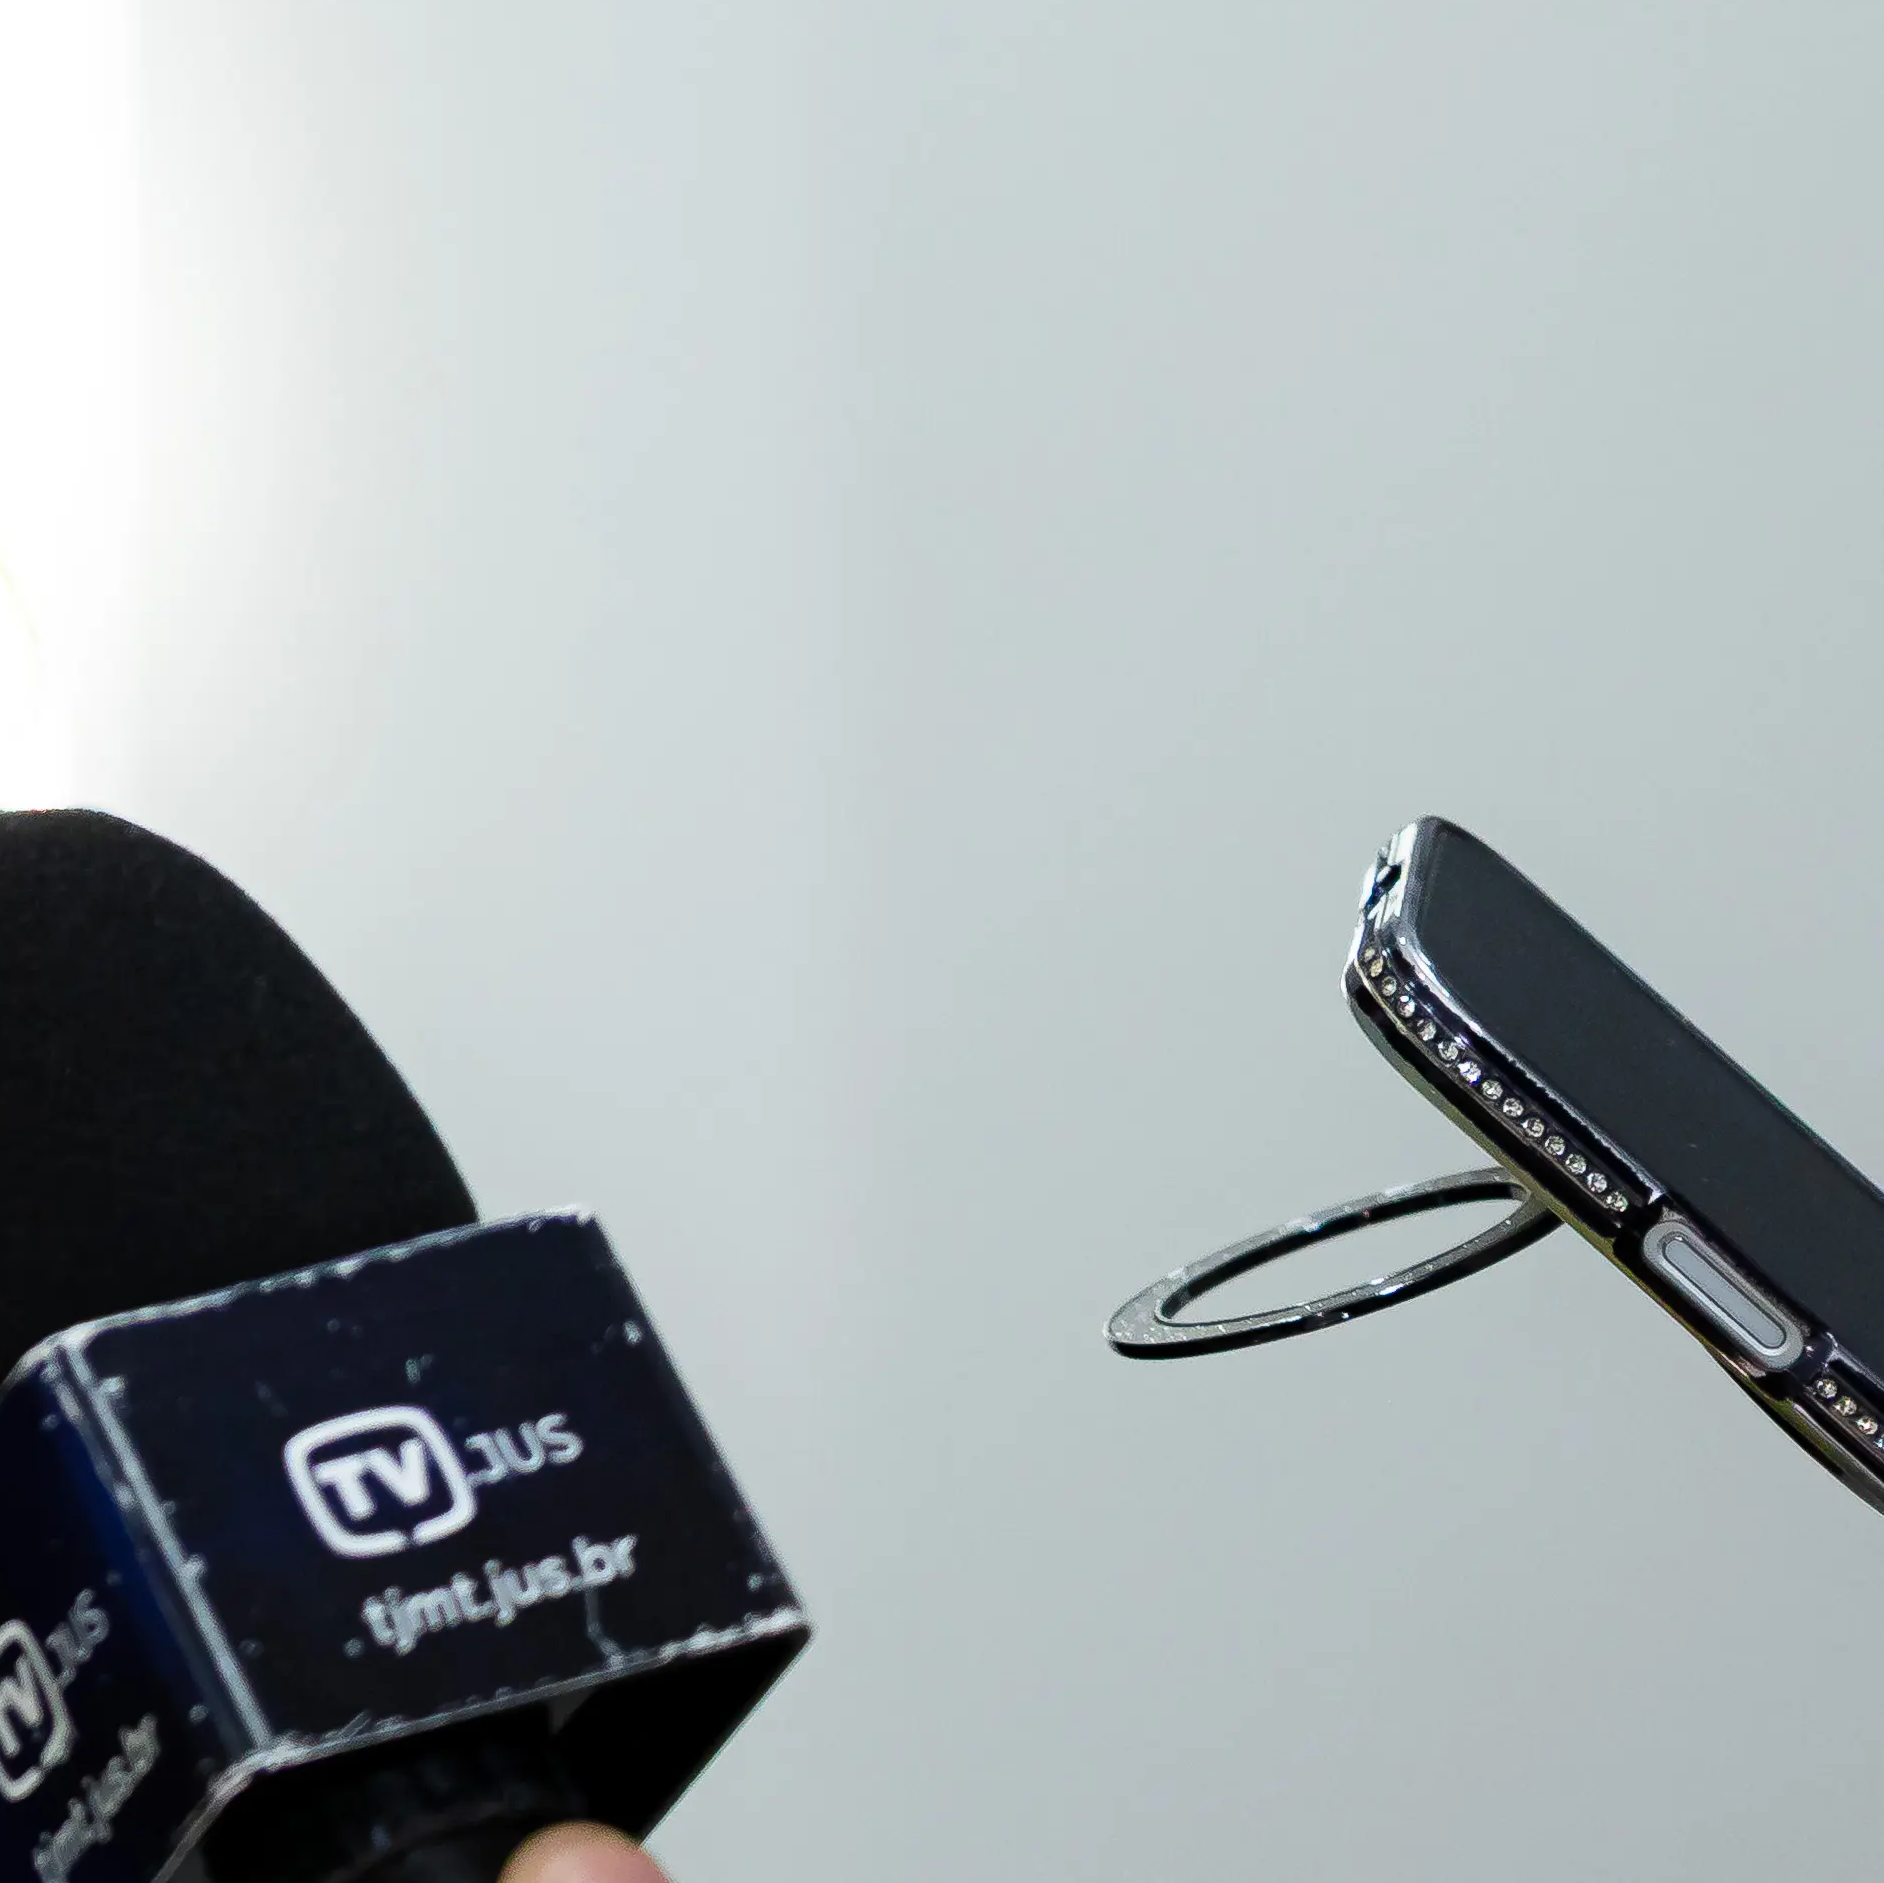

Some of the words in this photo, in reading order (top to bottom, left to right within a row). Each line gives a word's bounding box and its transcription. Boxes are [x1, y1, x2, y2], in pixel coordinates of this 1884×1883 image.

[313, 1438, 431, 1522] TV
[464, 1413, 584, 1485] JUS
[44, 1588, 110, 1688] JUS
[361, 1534, 638, 1656] tjmt.jus.br
